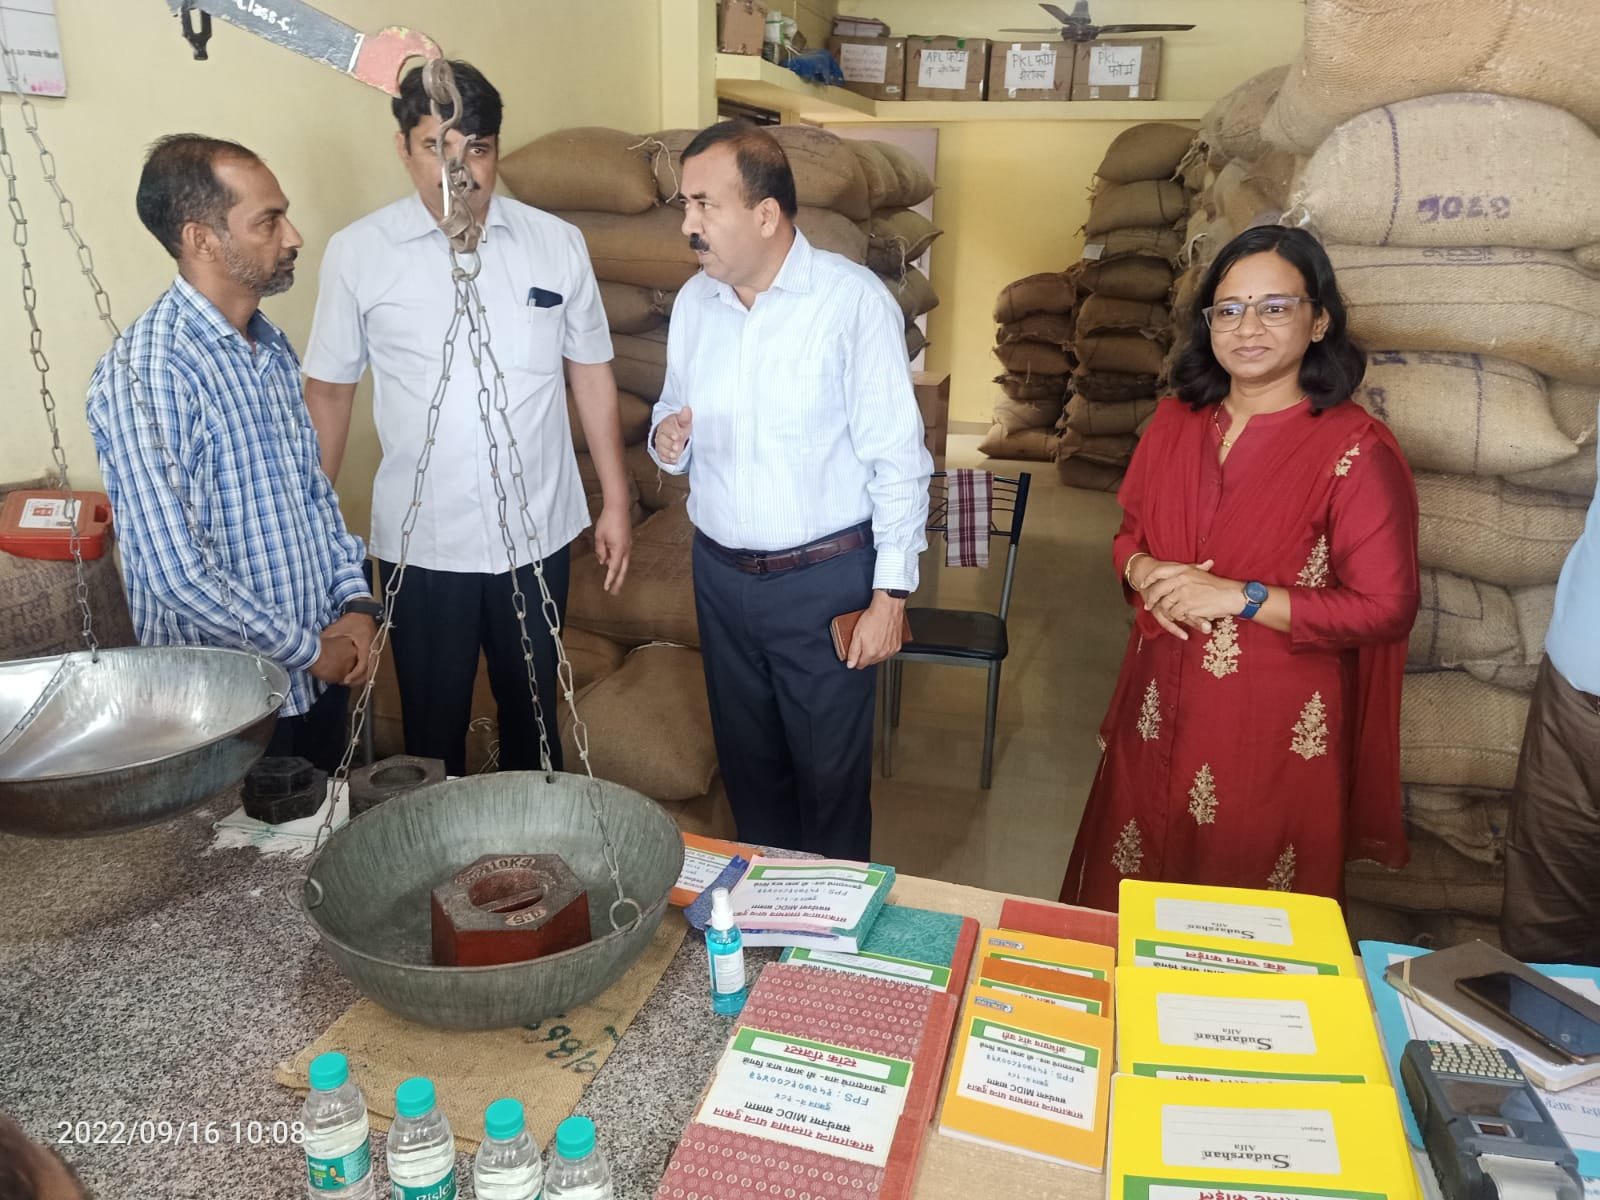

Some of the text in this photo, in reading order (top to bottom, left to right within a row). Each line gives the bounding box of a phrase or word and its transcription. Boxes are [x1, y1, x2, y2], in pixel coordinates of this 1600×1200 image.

[1187, 924, 1254, 940] Sudarshan
[1185, 950, 1223, 963] फाईल
[1226, 956, 1259, 969] चलन
[1195, 1032, 1272, 1050] Sudarshan
[784, 1044, 857, 1068] स्टॉक रजिस्टर
[1010, 1084, 1034, 1097] MIDC
[844, 1093, 869, 1106] FPS
[744, 1102, 773, 1114] सातारा
[775, 1108, 808, 1122] MIDC
[712, 1108, 874, 1153] सरकारमान्य रास्तभाव धान्य दुकान
[1234, 1144, 1257, 1152] Alfa
[1204, 1150, 1290, 1169] Sudarshan
